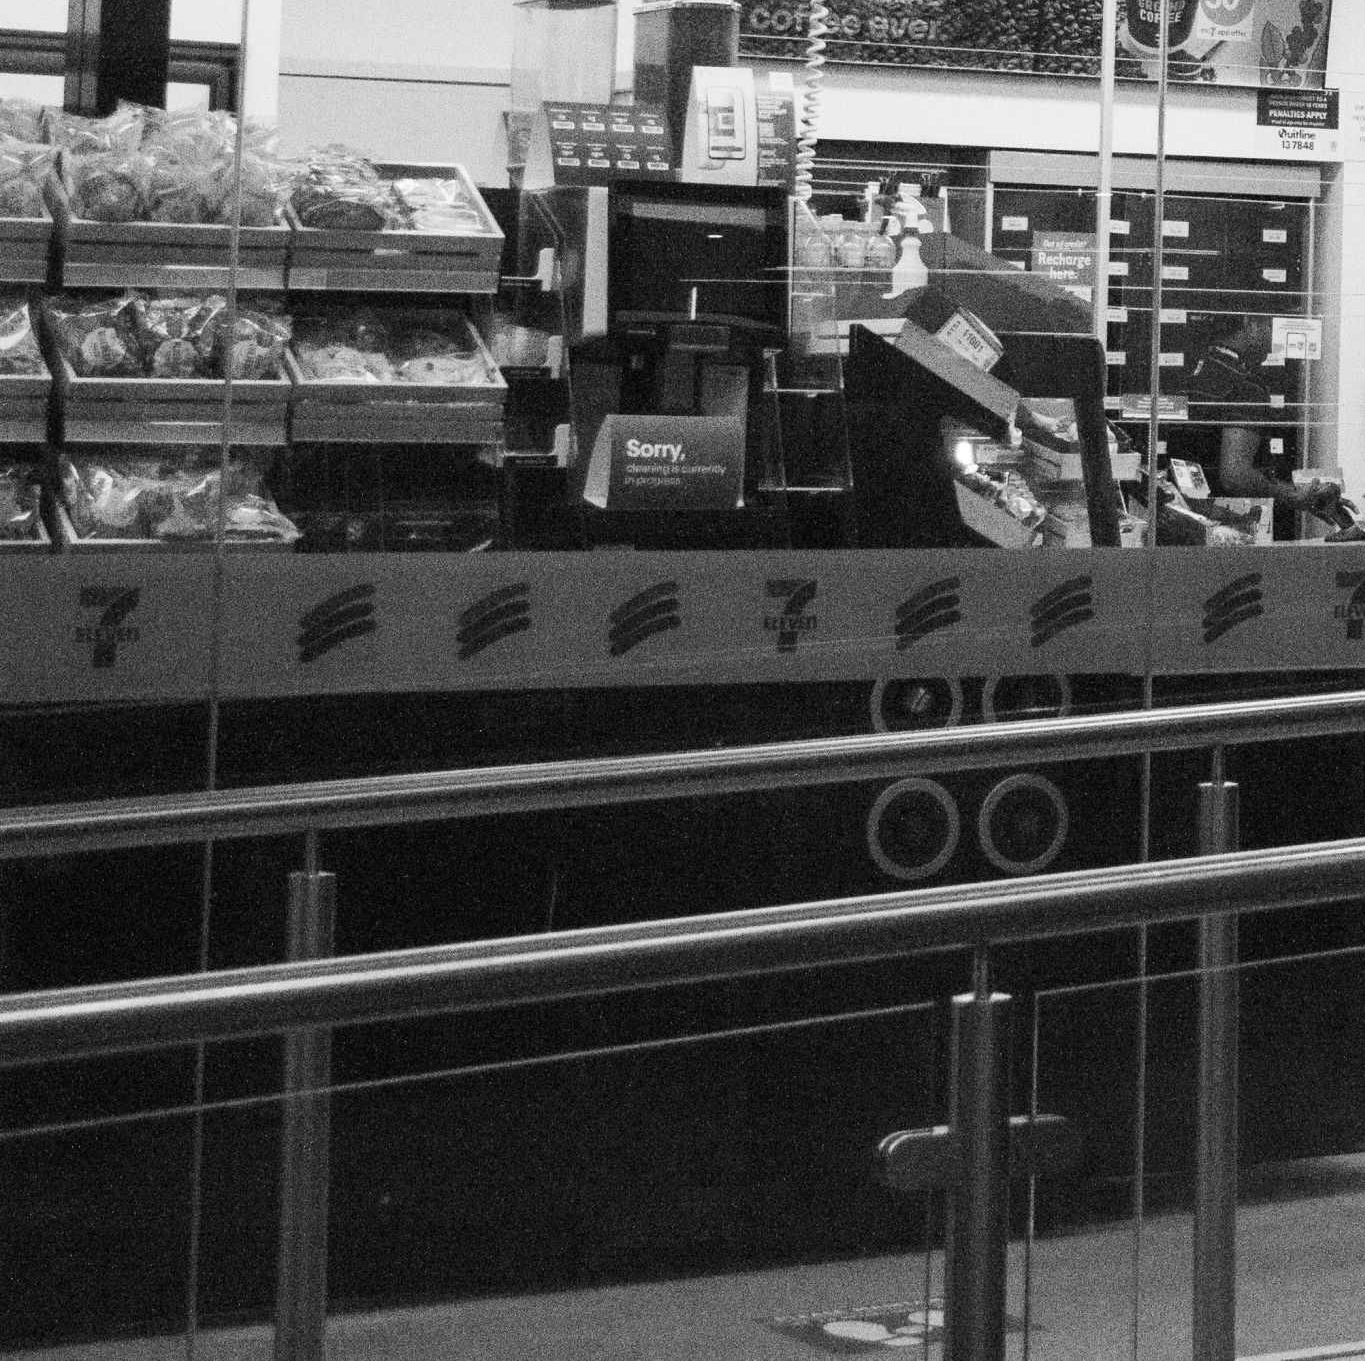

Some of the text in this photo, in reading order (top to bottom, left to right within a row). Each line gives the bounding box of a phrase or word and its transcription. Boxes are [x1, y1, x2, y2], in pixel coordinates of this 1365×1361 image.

[1269, 109, 1327, 120] PENALTIES APPLY
[1038, 251, 1091, 269] Recharge
[1050, 267, 1079, 279] here.
[626, 438, 686, 463] Sorry,
